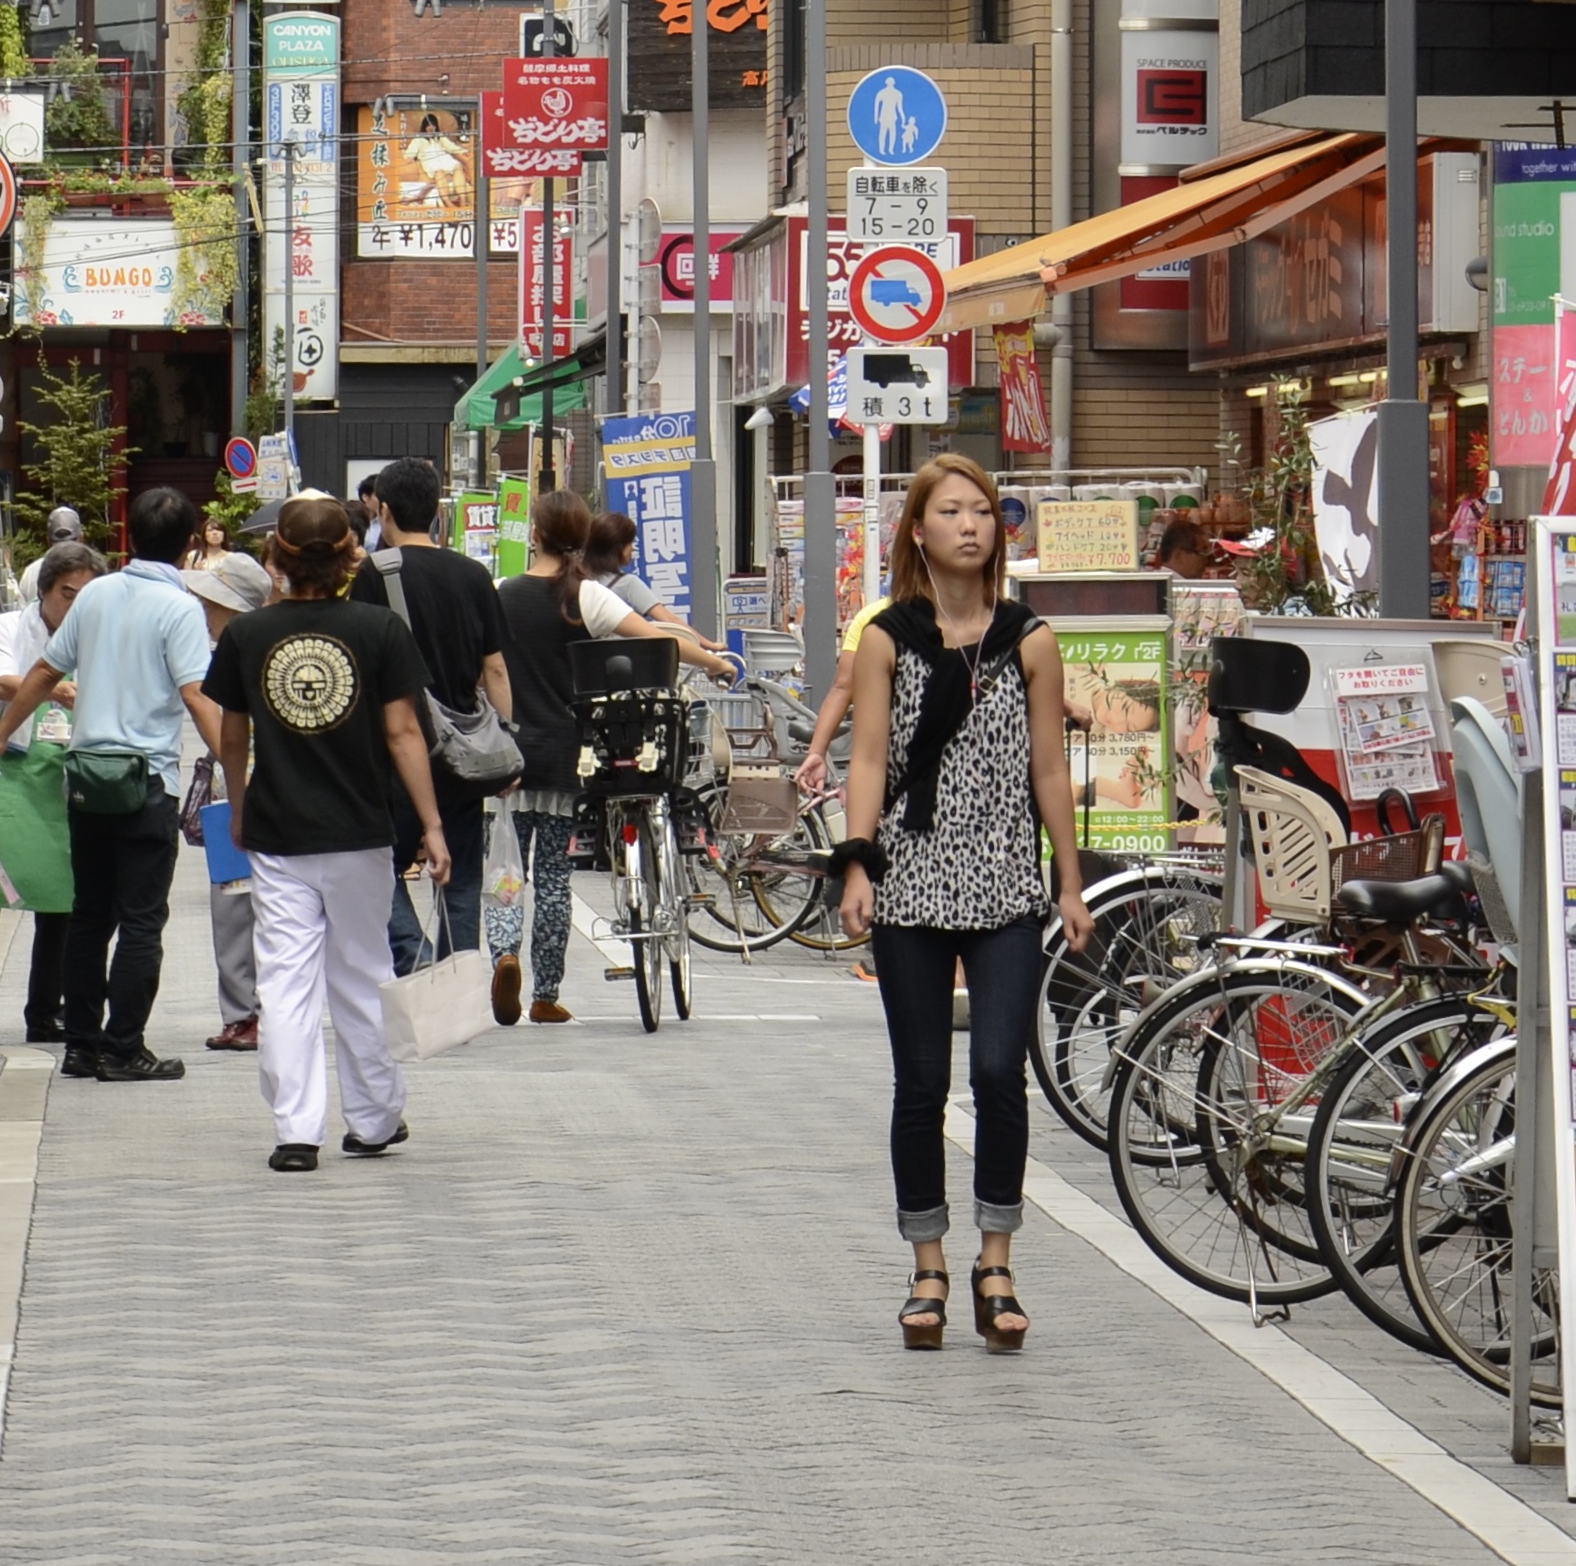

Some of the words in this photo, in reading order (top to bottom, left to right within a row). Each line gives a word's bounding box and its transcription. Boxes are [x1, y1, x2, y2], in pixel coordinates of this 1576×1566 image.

[273, 25, 331, 36] CANYON
[279, 40, 324, 51] PLAZA
[1137, 59, 1165, 68] SPACE
[1167, 60, 1207, 69] PRODUCE
[855, 176, 938, 194] 自転車を除く
[400, 223, 472, 250] ¥1,470
[85, 266, 152, 287] BUNGO
[112, 310, 125, 320] 2F
[863, 397, 883, 418] 積
[899, 397, 911, 417] 3
[924, 397, 932, 417] t
[1143, 646, 1161, 659] 2F
[1338, 667, 1425, 680] フタを開いてご自由に
[1353, 680, 1414, 689] お取りください
